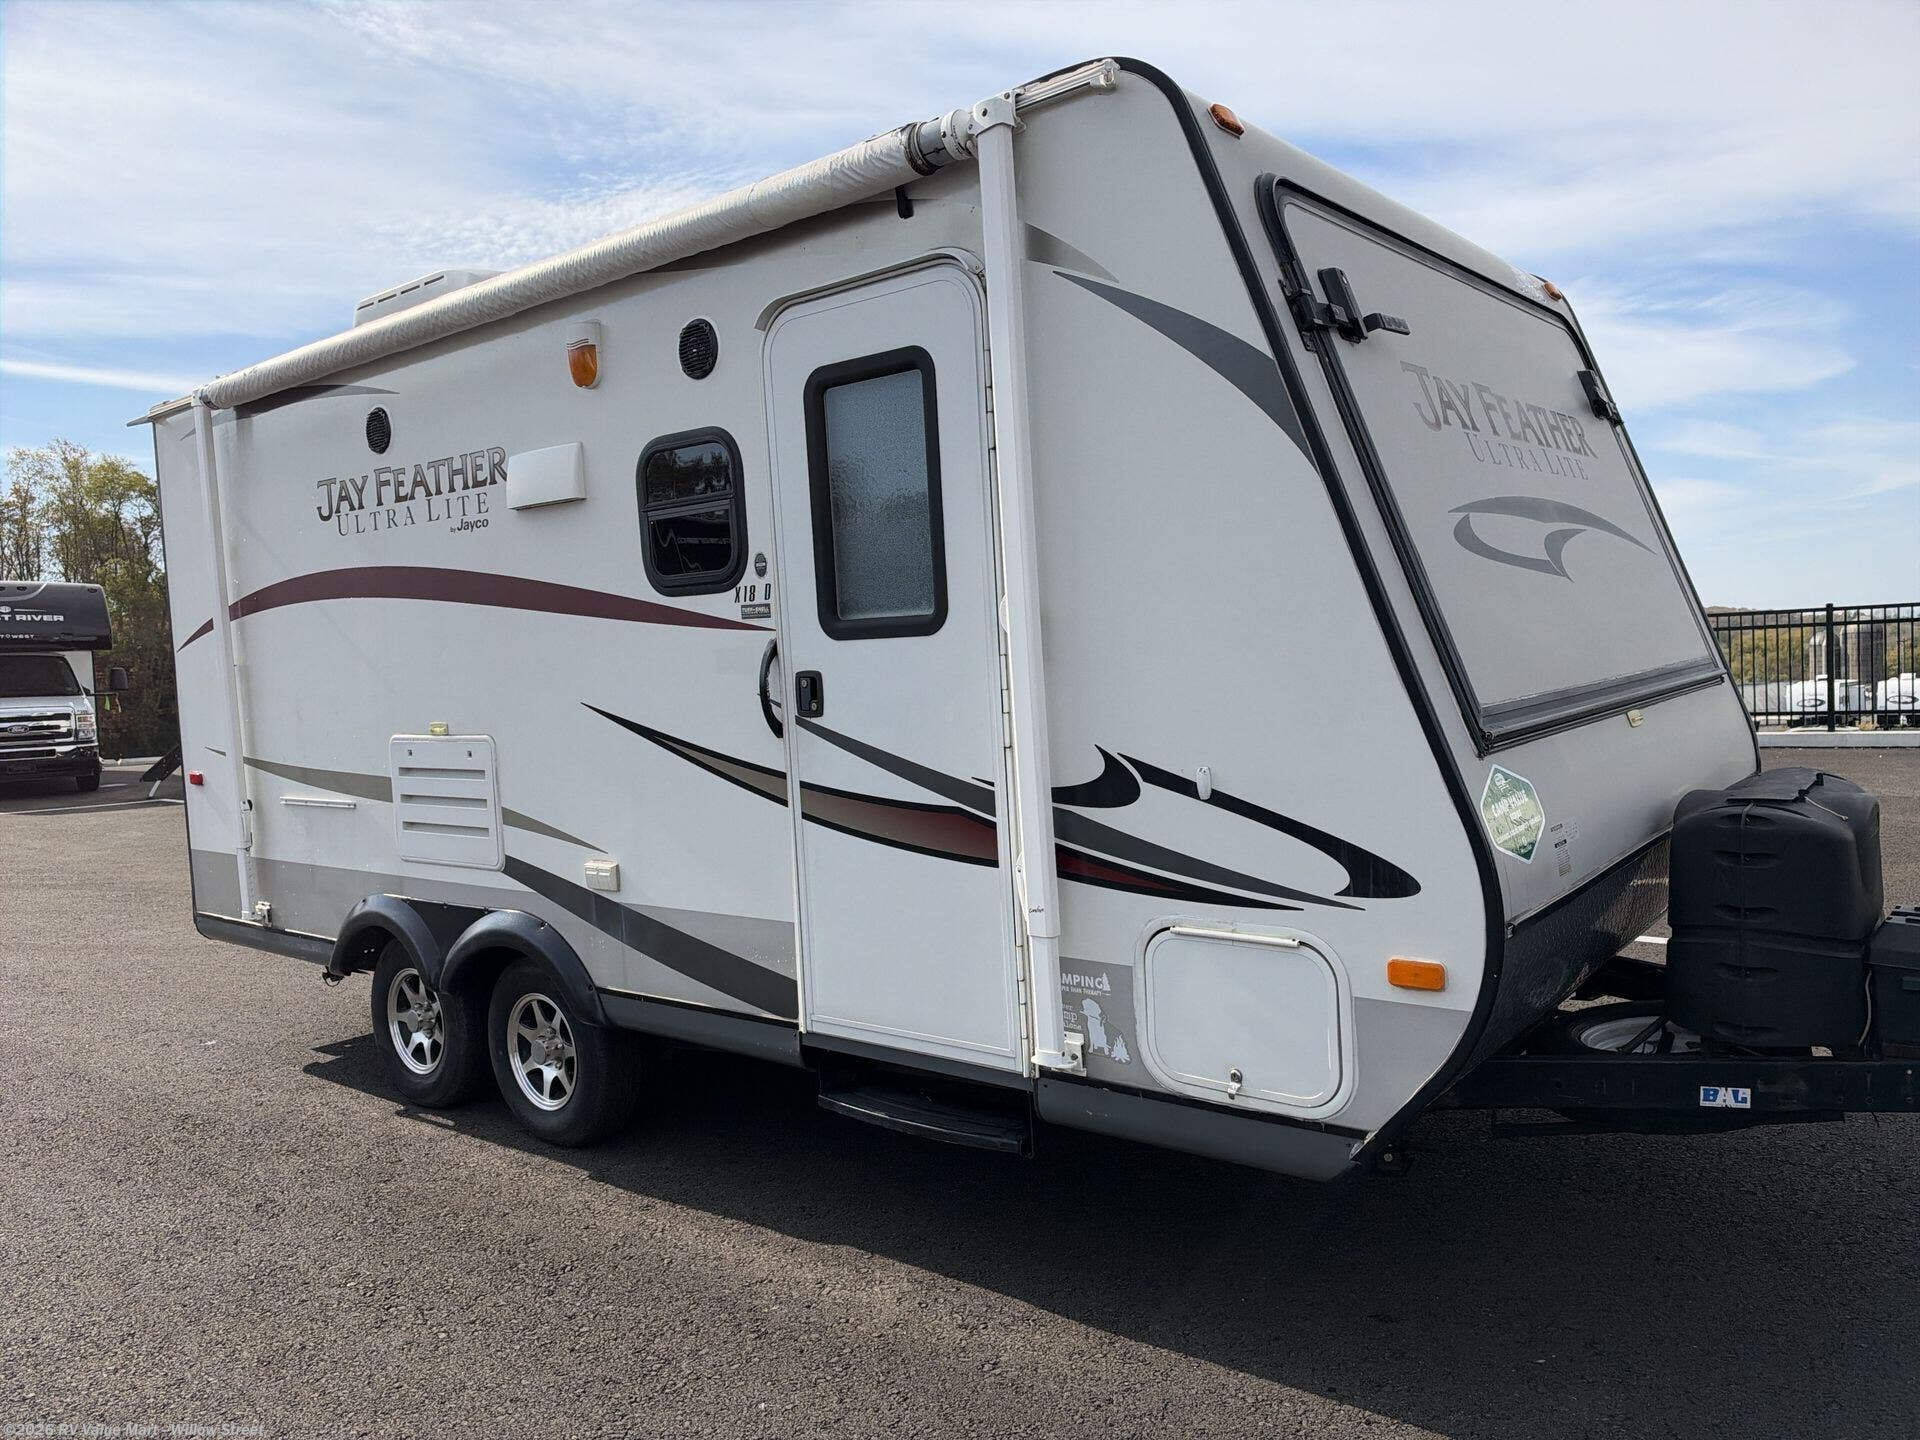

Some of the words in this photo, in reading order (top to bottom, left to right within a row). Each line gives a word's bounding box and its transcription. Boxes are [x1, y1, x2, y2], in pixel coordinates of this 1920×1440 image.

[1400, 360, 1480, 432] JAY
[1471, 382, 1598, 459] FEATHER
[1464, 432, 1543, 472] ULTRA
[1542, 448, 1589, 481] LITE
[316, 475, 369, 522] JAY
[373, 446, 508, 507] FEATHER
[336, 506, 416, 537] ULTRA
[426, 492, 490, 523] LITE
[457, 518, 489, 533] Jayco
[734, 585, 756, 603] X18
[764, 583, 771, 600] D
[15, 614, 64, 622] RIVER
[1061, 972, 1103, 990] MPING
[1702, 1088, 1748, 1104] BAL
